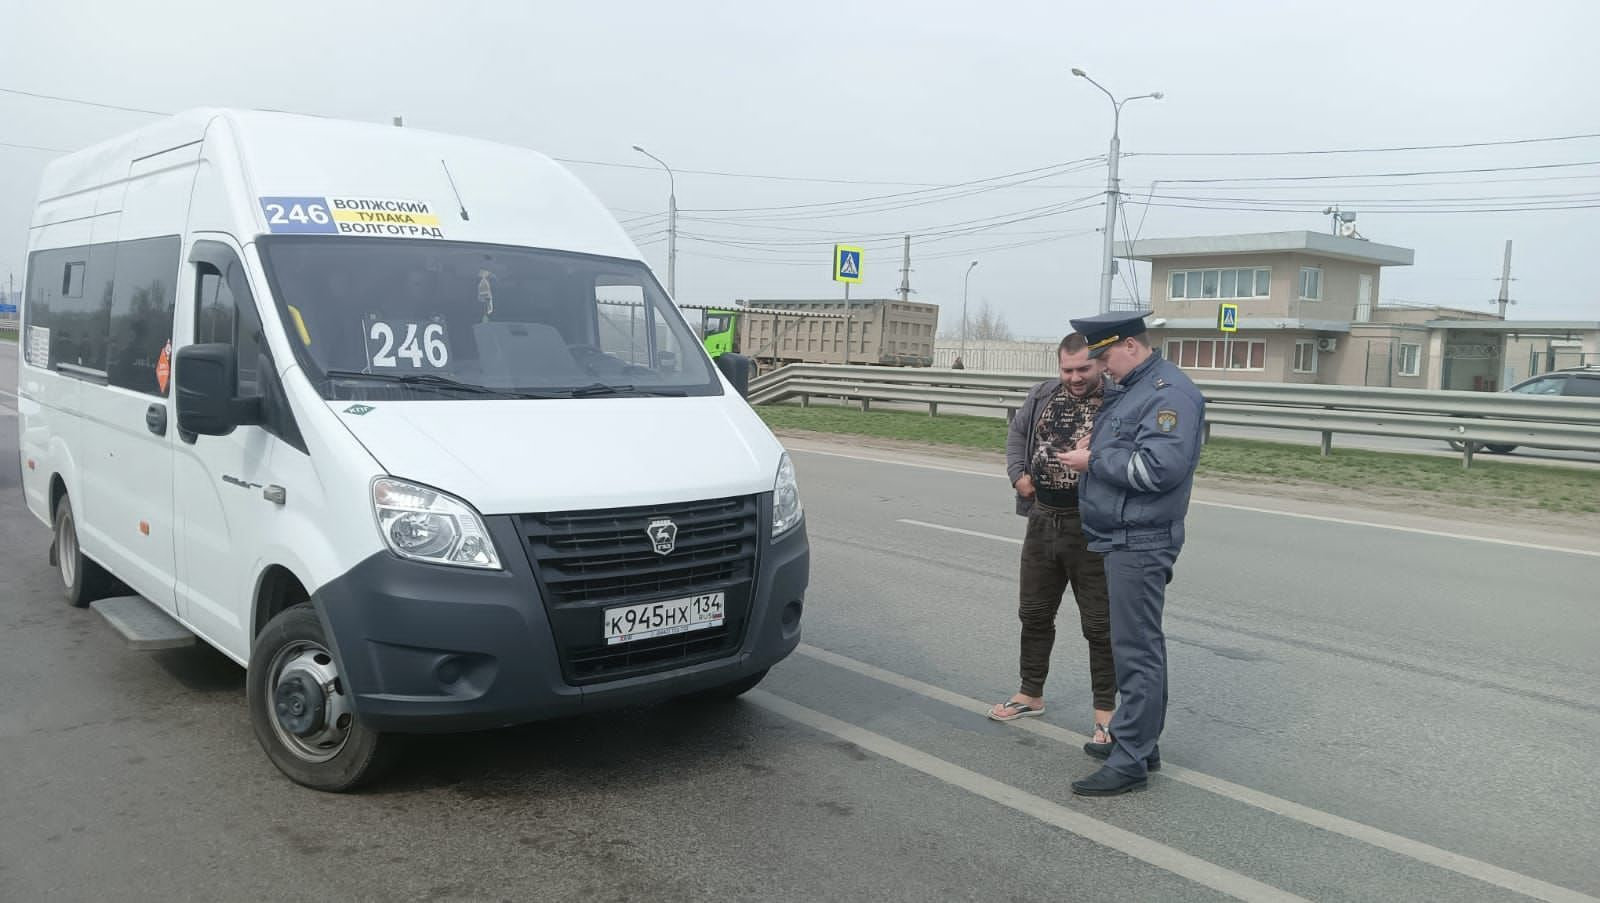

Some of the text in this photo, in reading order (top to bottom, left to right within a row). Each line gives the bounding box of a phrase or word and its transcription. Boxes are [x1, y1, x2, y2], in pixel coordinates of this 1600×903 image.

[266, 204, 329, 224] 246
[334, 199, 429, 213] ВОЛЖСКИЙ
[340, 223, 444, 239] ВОЛГОГРАД
[370, 322, 448, 368] 246
[611, 605, 688, 634] К945НХ
[693, 595, 720, 614] 134
